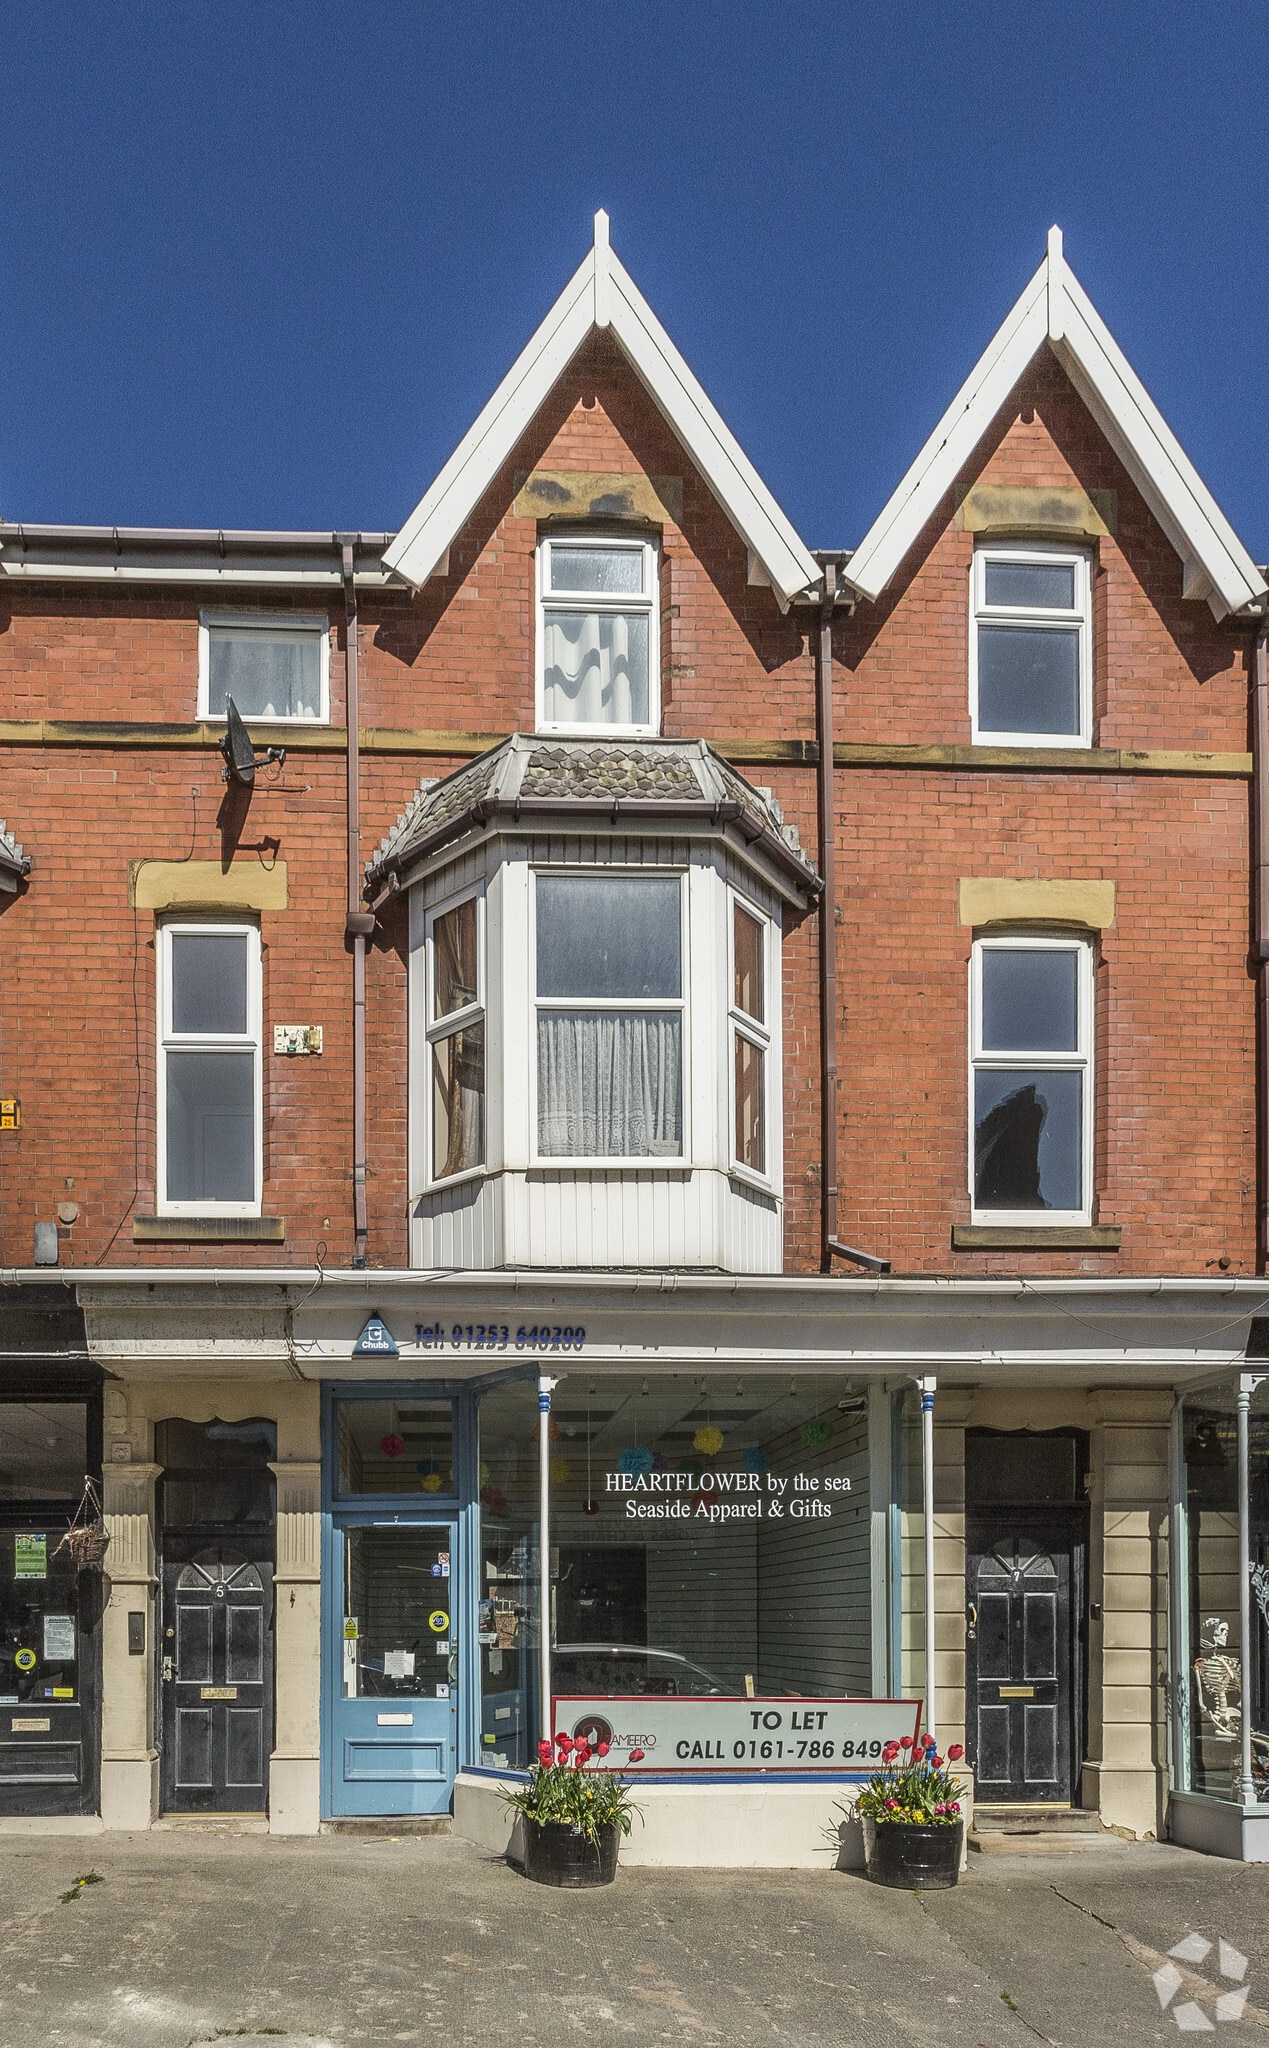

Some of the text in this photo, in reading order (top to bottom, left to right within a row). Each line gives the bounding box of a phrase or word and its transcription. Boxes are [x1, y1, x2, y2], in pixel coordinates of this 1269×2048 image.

[415, 1323, 586, 1343] Tel: 01253 640200
[361, 1340, 389, 1349] Chubb
[605, 1472, 852, 1495] HEARTFLOWER by the sea
[625, 1499, 832, 1523] Seaside Apparel & Gifts
[1013, 1571, 1020, 1581] 7
[216, 1585, 224, 1598] 5
[750, 1711, 828, 1730] TO LET
[675, 1740, 725, 1759] CALL
[733, 1740, 835, 1759] 0161-786
